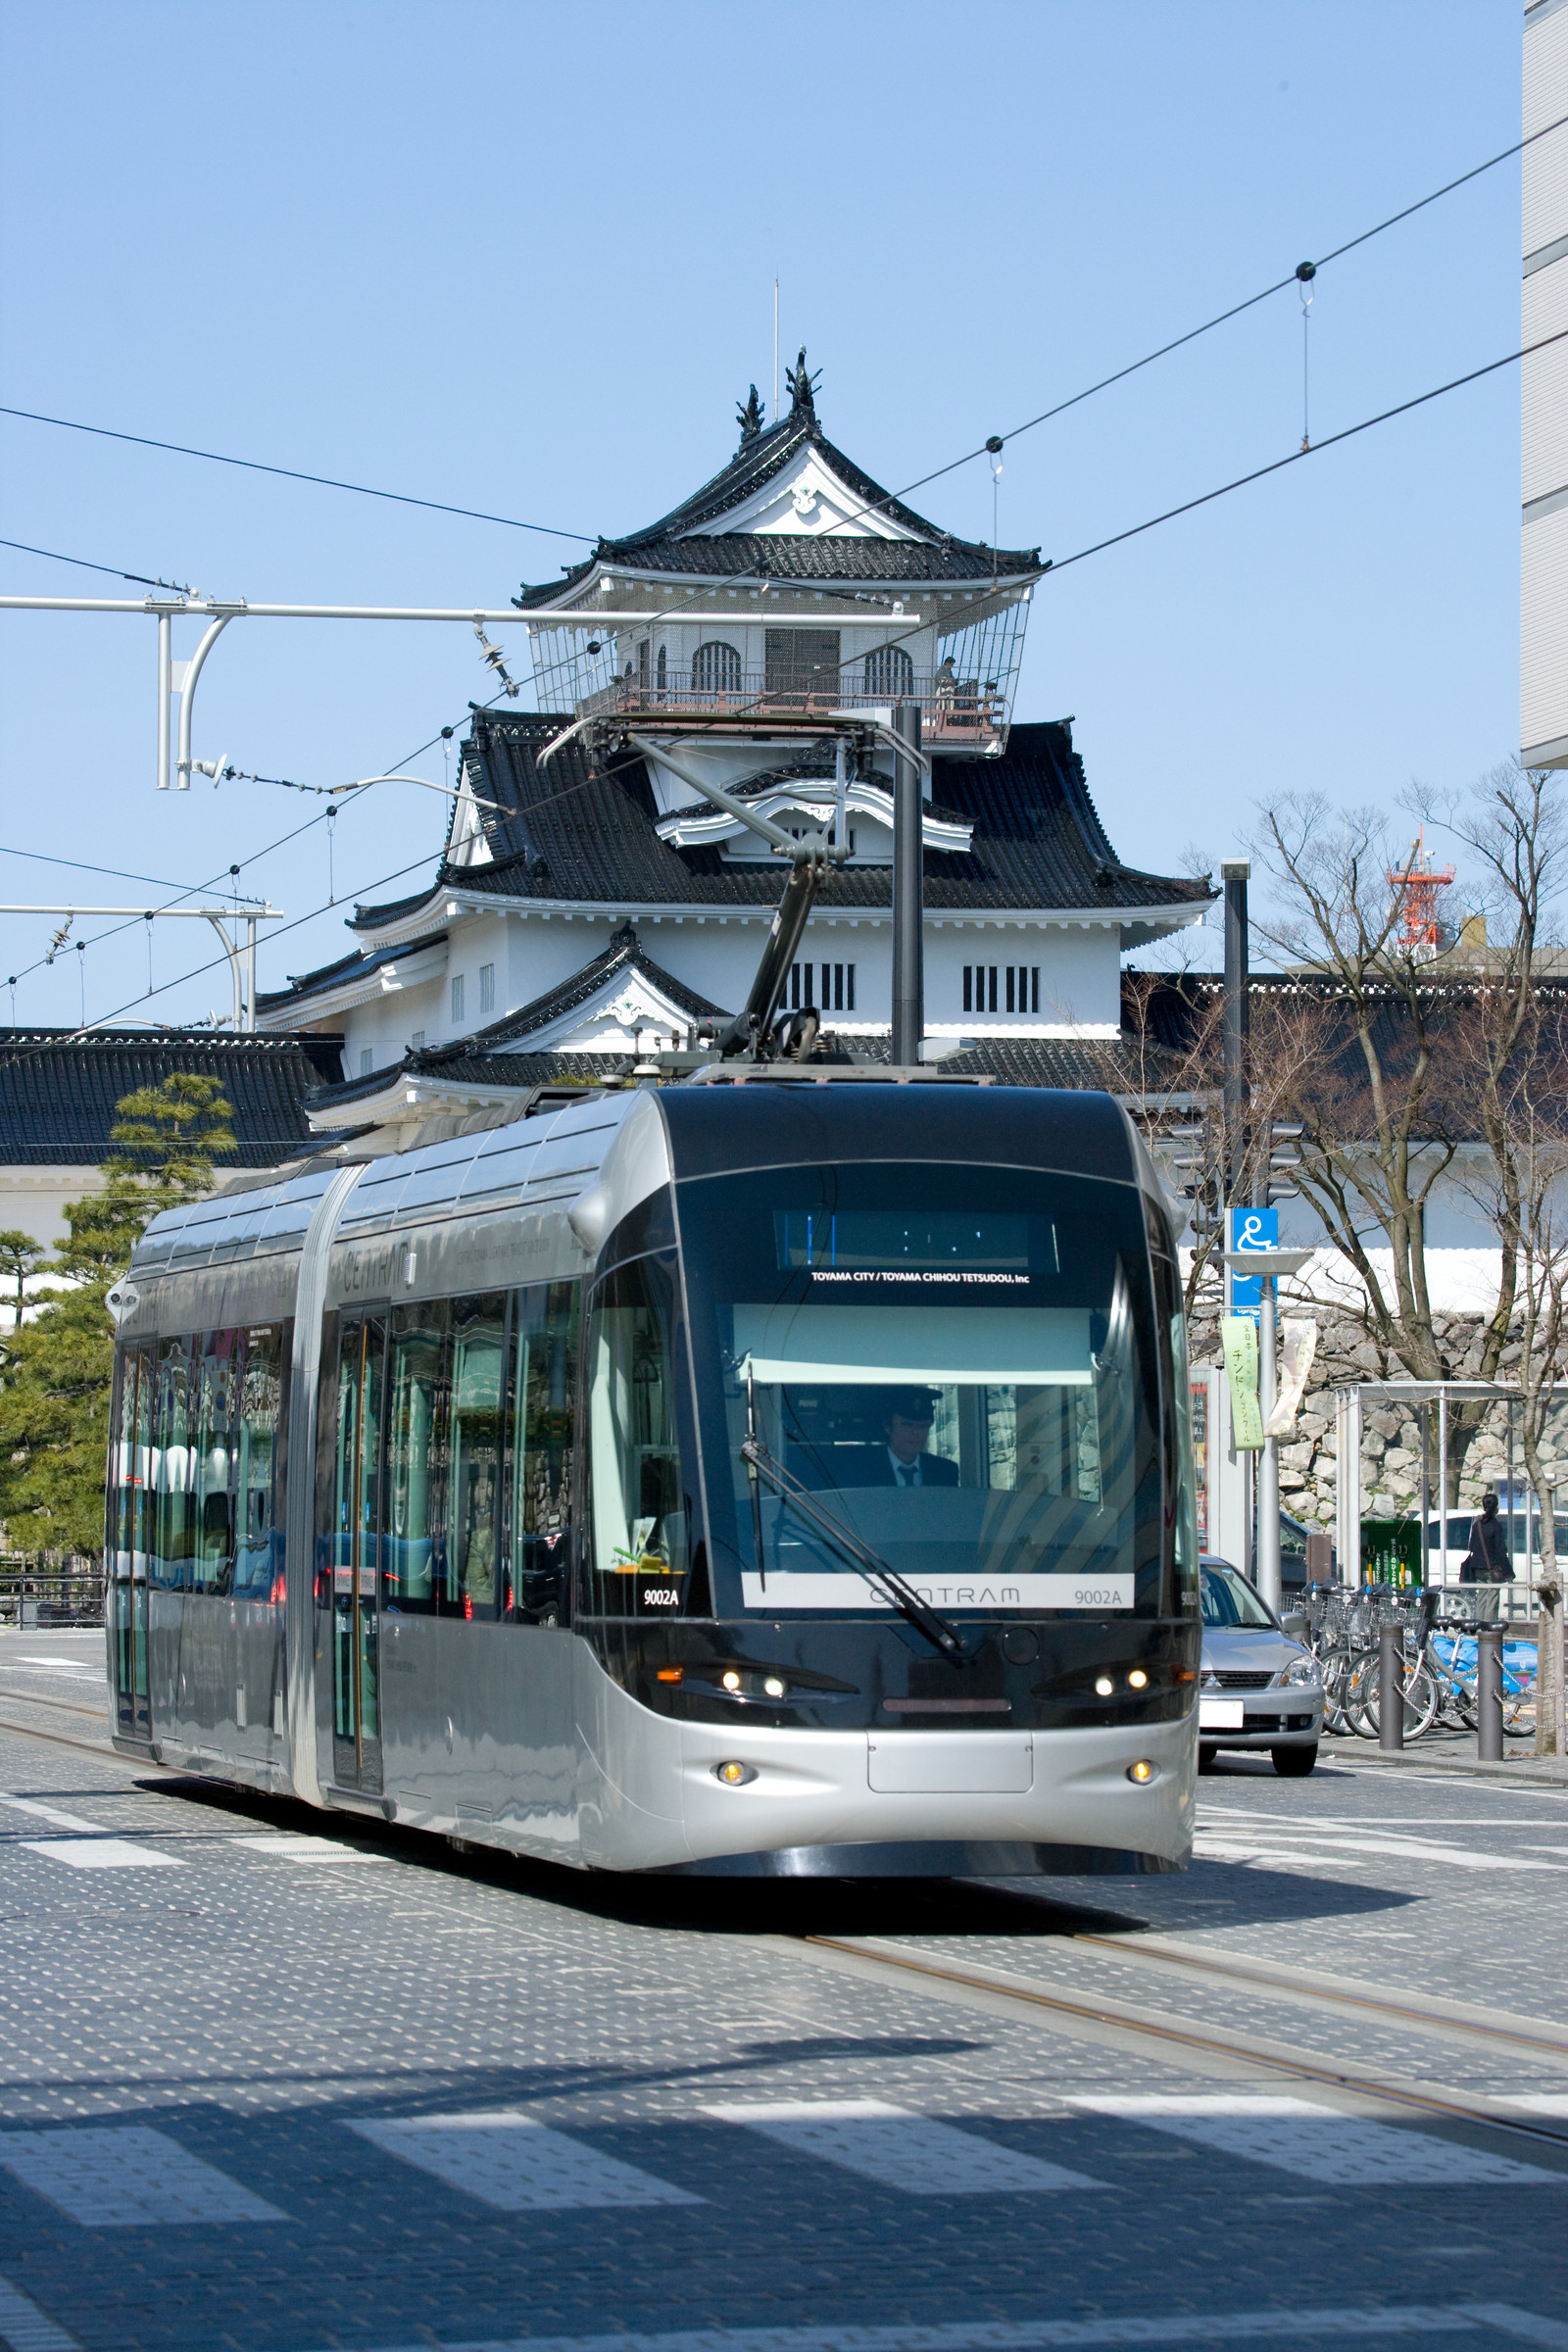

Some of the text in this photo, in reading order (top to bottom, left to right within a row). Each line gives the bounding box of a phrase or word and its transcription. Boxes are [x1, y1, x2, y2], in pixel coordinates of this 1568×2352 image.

[811, 1272, 852, 1281] TOYAMA
[854, 1272, 874, 1282] CITY
[881, 1273, 921, 1282] TOYAMA
[922, 1273, 960, 1282] CHIHOU
[644, 1589, 679, 1605] 9002A
[1074, 1591, 1122, 1604] 9002A
